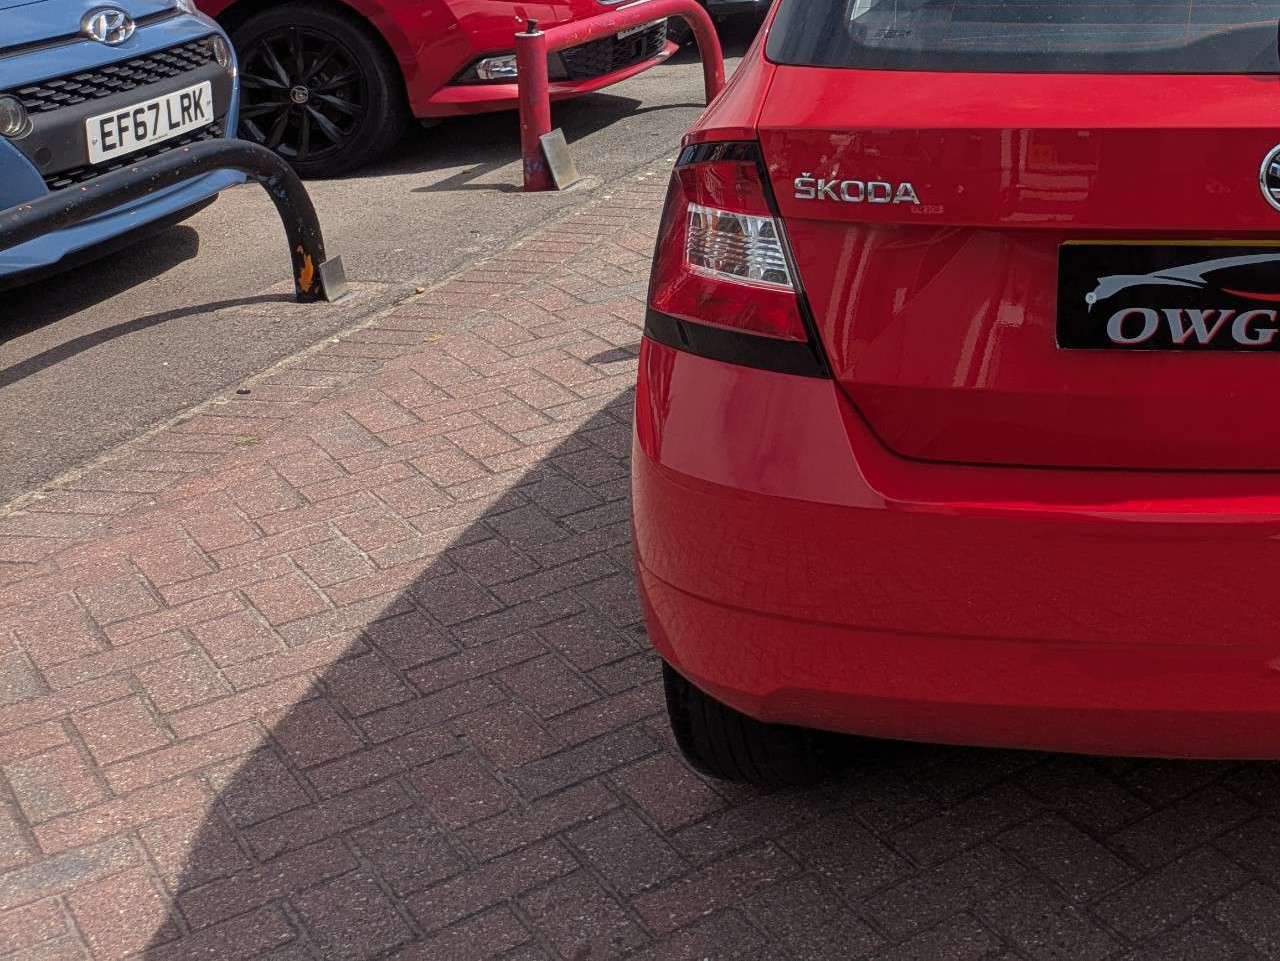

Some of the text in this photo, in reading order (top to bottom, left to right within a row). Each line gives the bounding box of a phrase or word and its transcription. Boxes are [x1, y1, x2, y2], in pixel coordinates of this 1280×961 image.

[100, 87, 205, 152] EF67 LRK
[794, 172, 920, 205] ŠKODA
[1106, 308, 1279, 345] OWG
